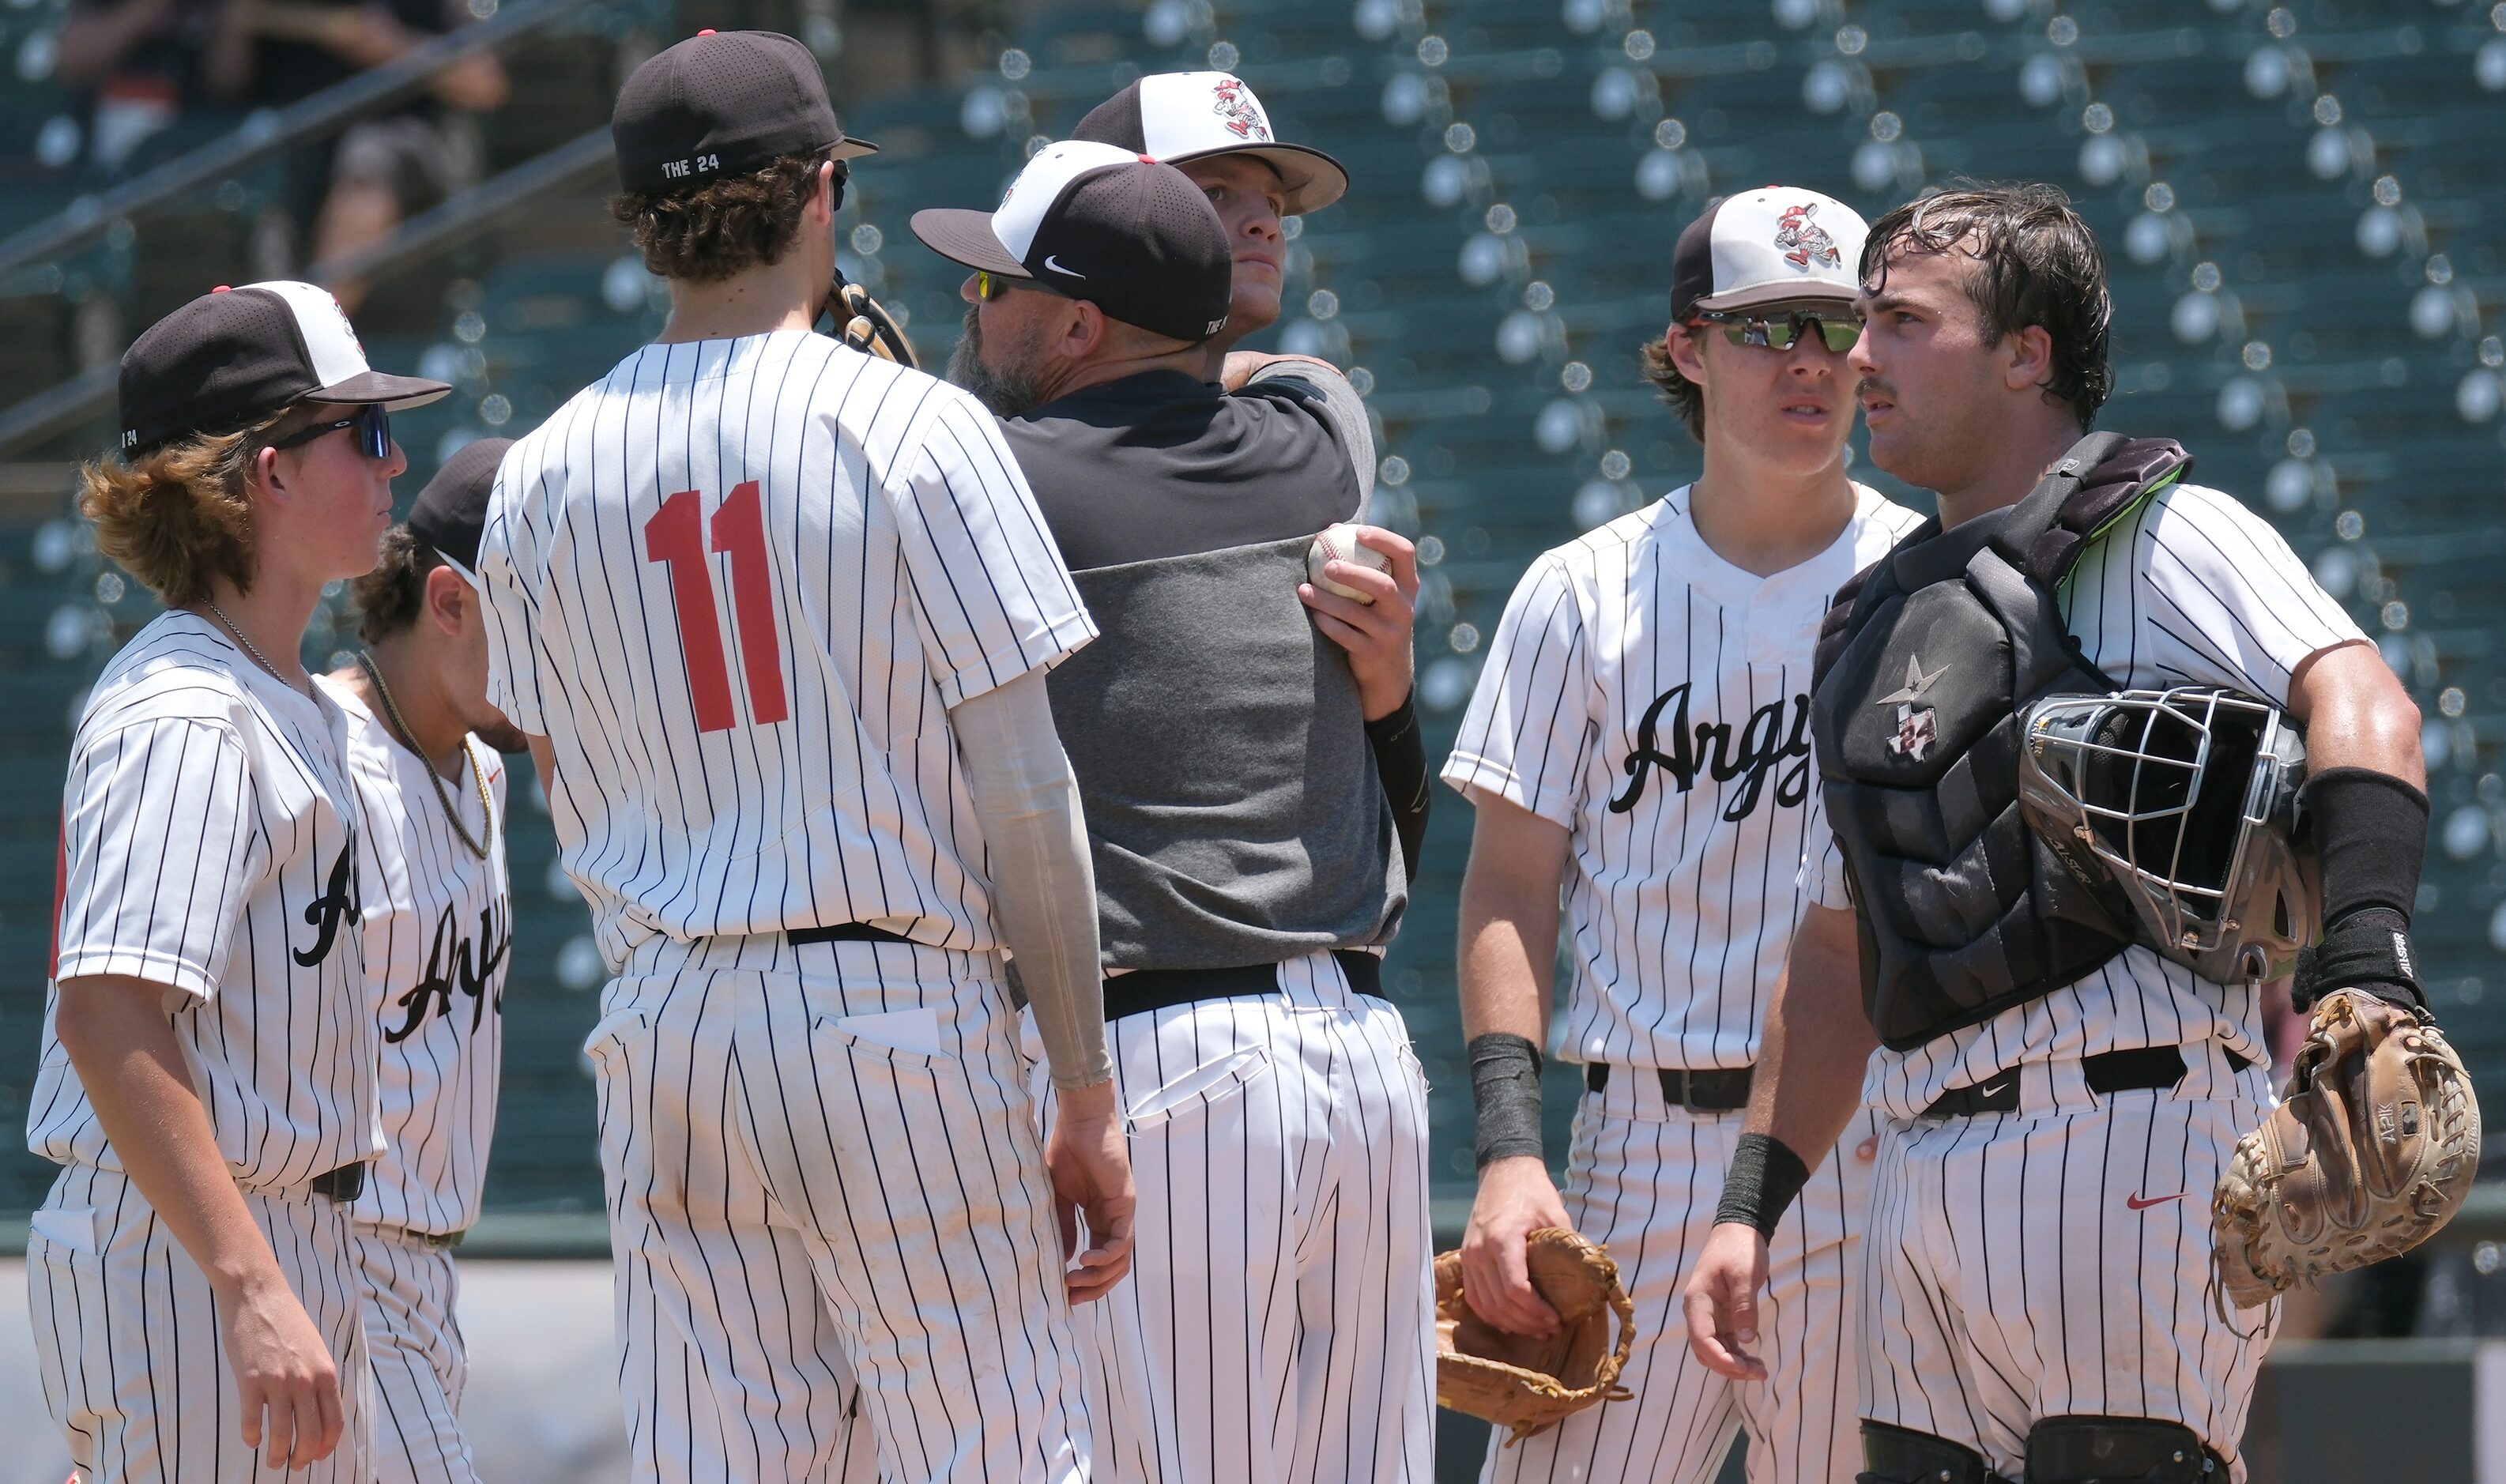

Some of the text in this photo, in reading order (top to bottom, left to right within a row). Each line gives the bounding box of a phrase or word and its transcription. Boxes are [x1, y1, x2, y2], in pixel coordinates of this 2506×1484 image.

[661, 153, 720, 179] THE 24
[126, 429, 138, 446] 24
[644, 480, 789, 733] 11
